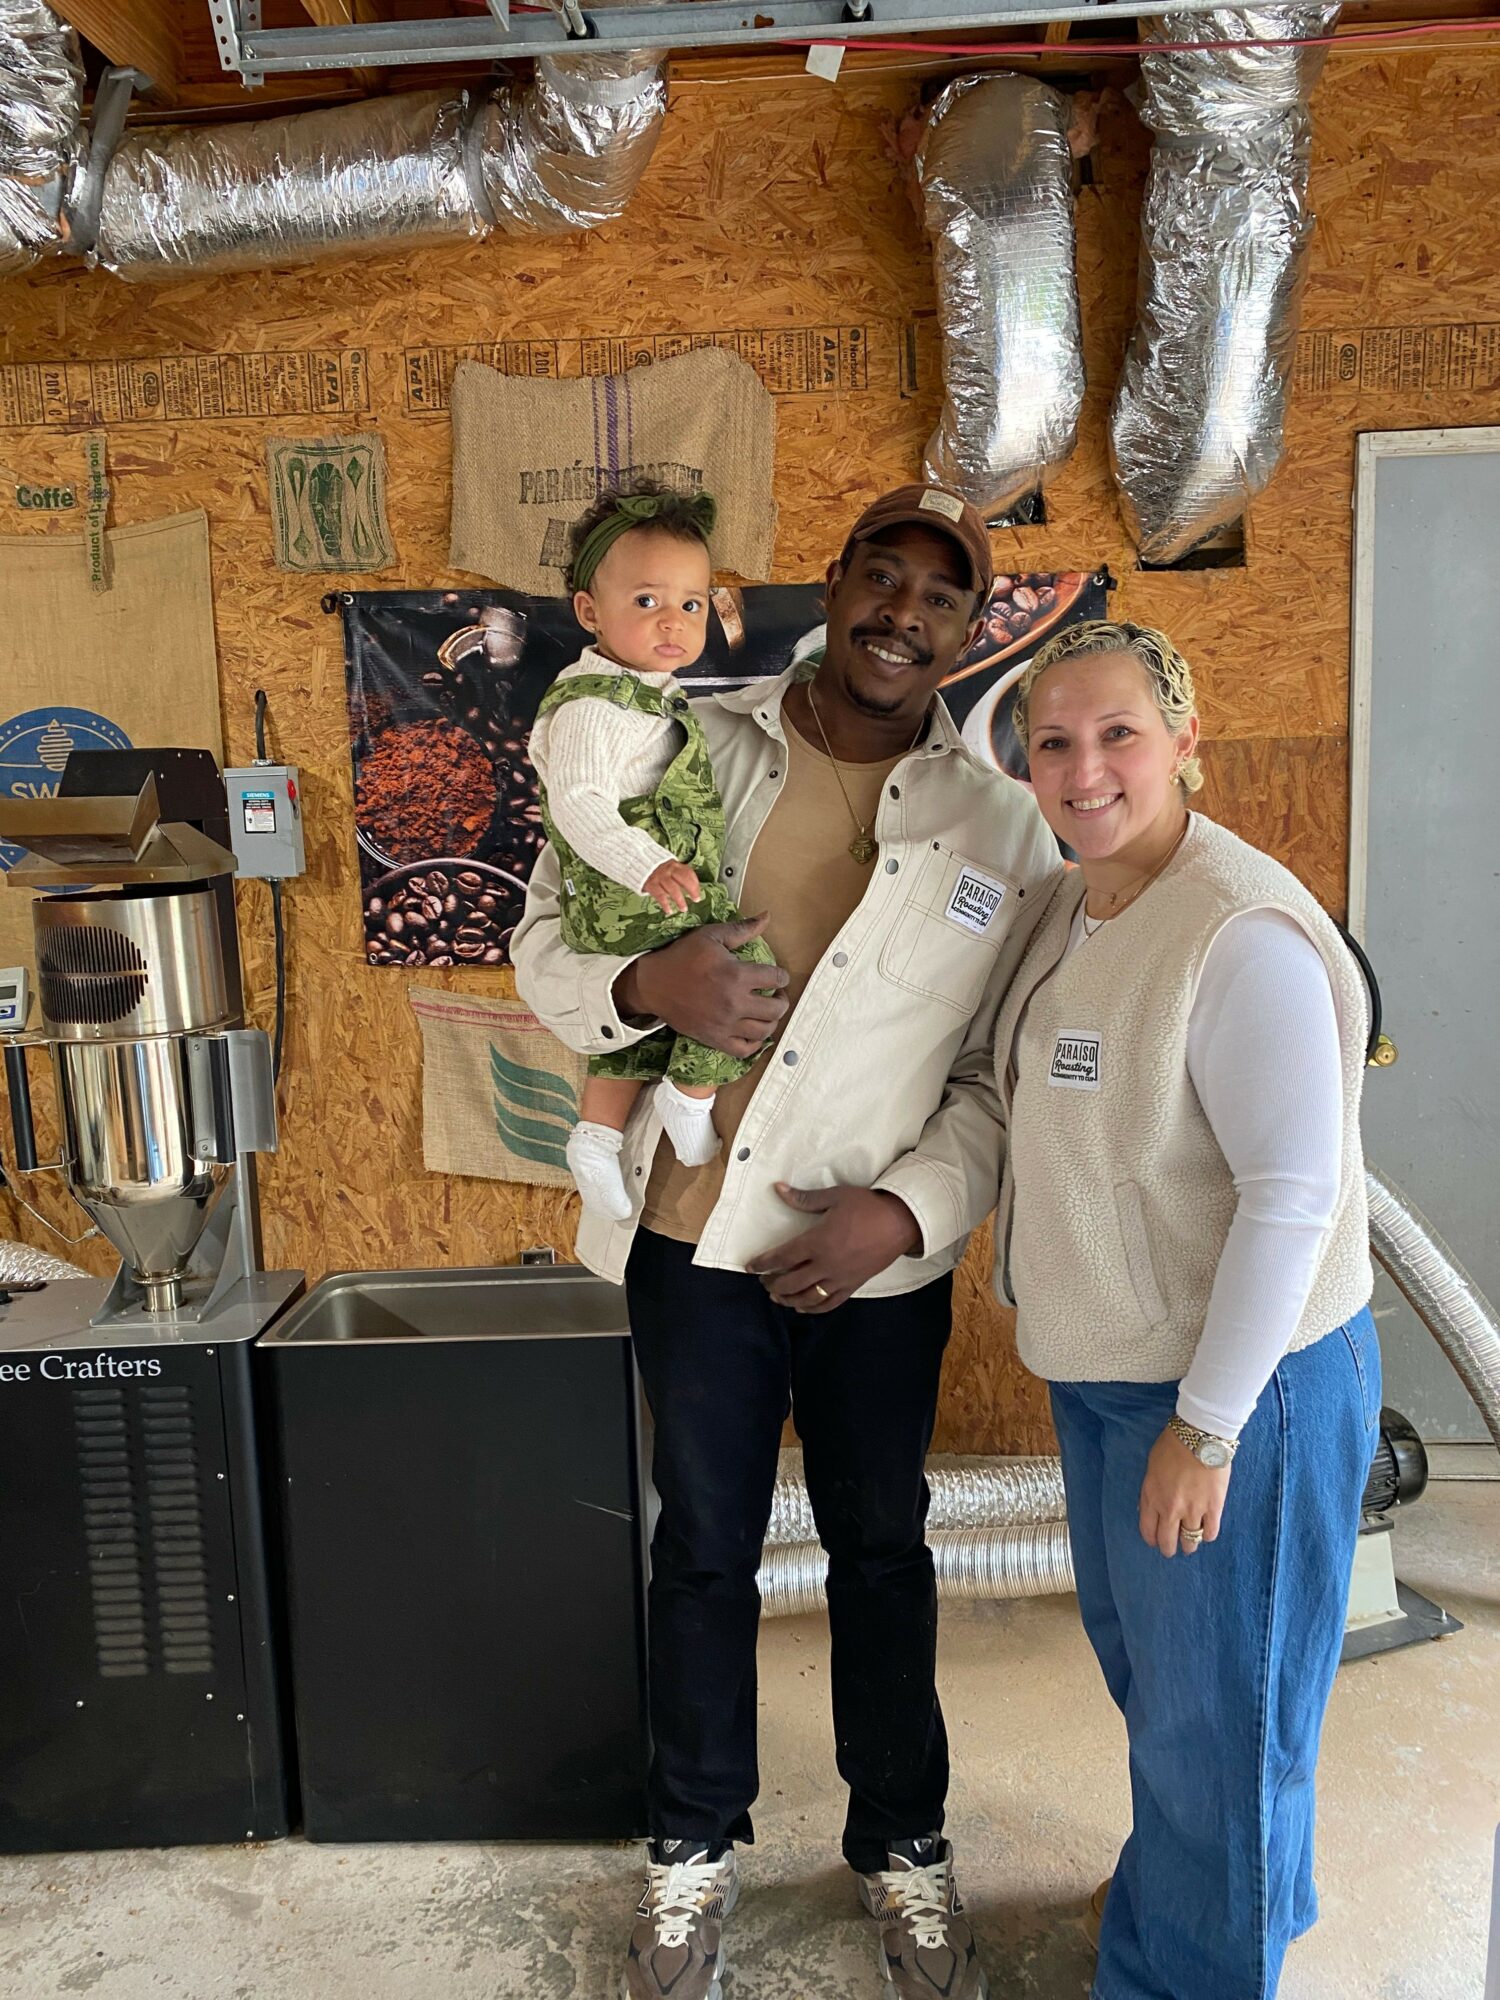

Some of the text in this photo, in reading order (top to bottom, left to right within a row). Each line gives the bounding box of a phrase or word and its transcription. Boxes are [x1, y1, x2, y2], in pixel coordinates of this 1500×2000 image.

[200, 359, 208, 373] ESTE
[824, 336, 836, 382] APA
[850, 345, 859, 387] Norbord
[1342, 348, 1353, 377] QMS
[45, 373, 62, 403] 2007
[209, 360, 220, 413] THIS SIDE DOWN
[326, 360, 339, 404] APA
[352, 367, 361, 409] Norbord
[410, 357, 423, 402] APA
[203, 396, 211, 415] ABAJO
[17, 487, 74, 508] Coffe
[89, 515, 99, 527] of
[89, 532, 101, 582] Product
[957, 896, 989, 920] Roasting
[960, 881, 999, 910] PARAÍSO
[1056, 1042, 1095, 1062] PARAÍSO
[1055, 1059, 1094, 1076] Roasting
[0, 1352, 161, 1382] ee Crafters
